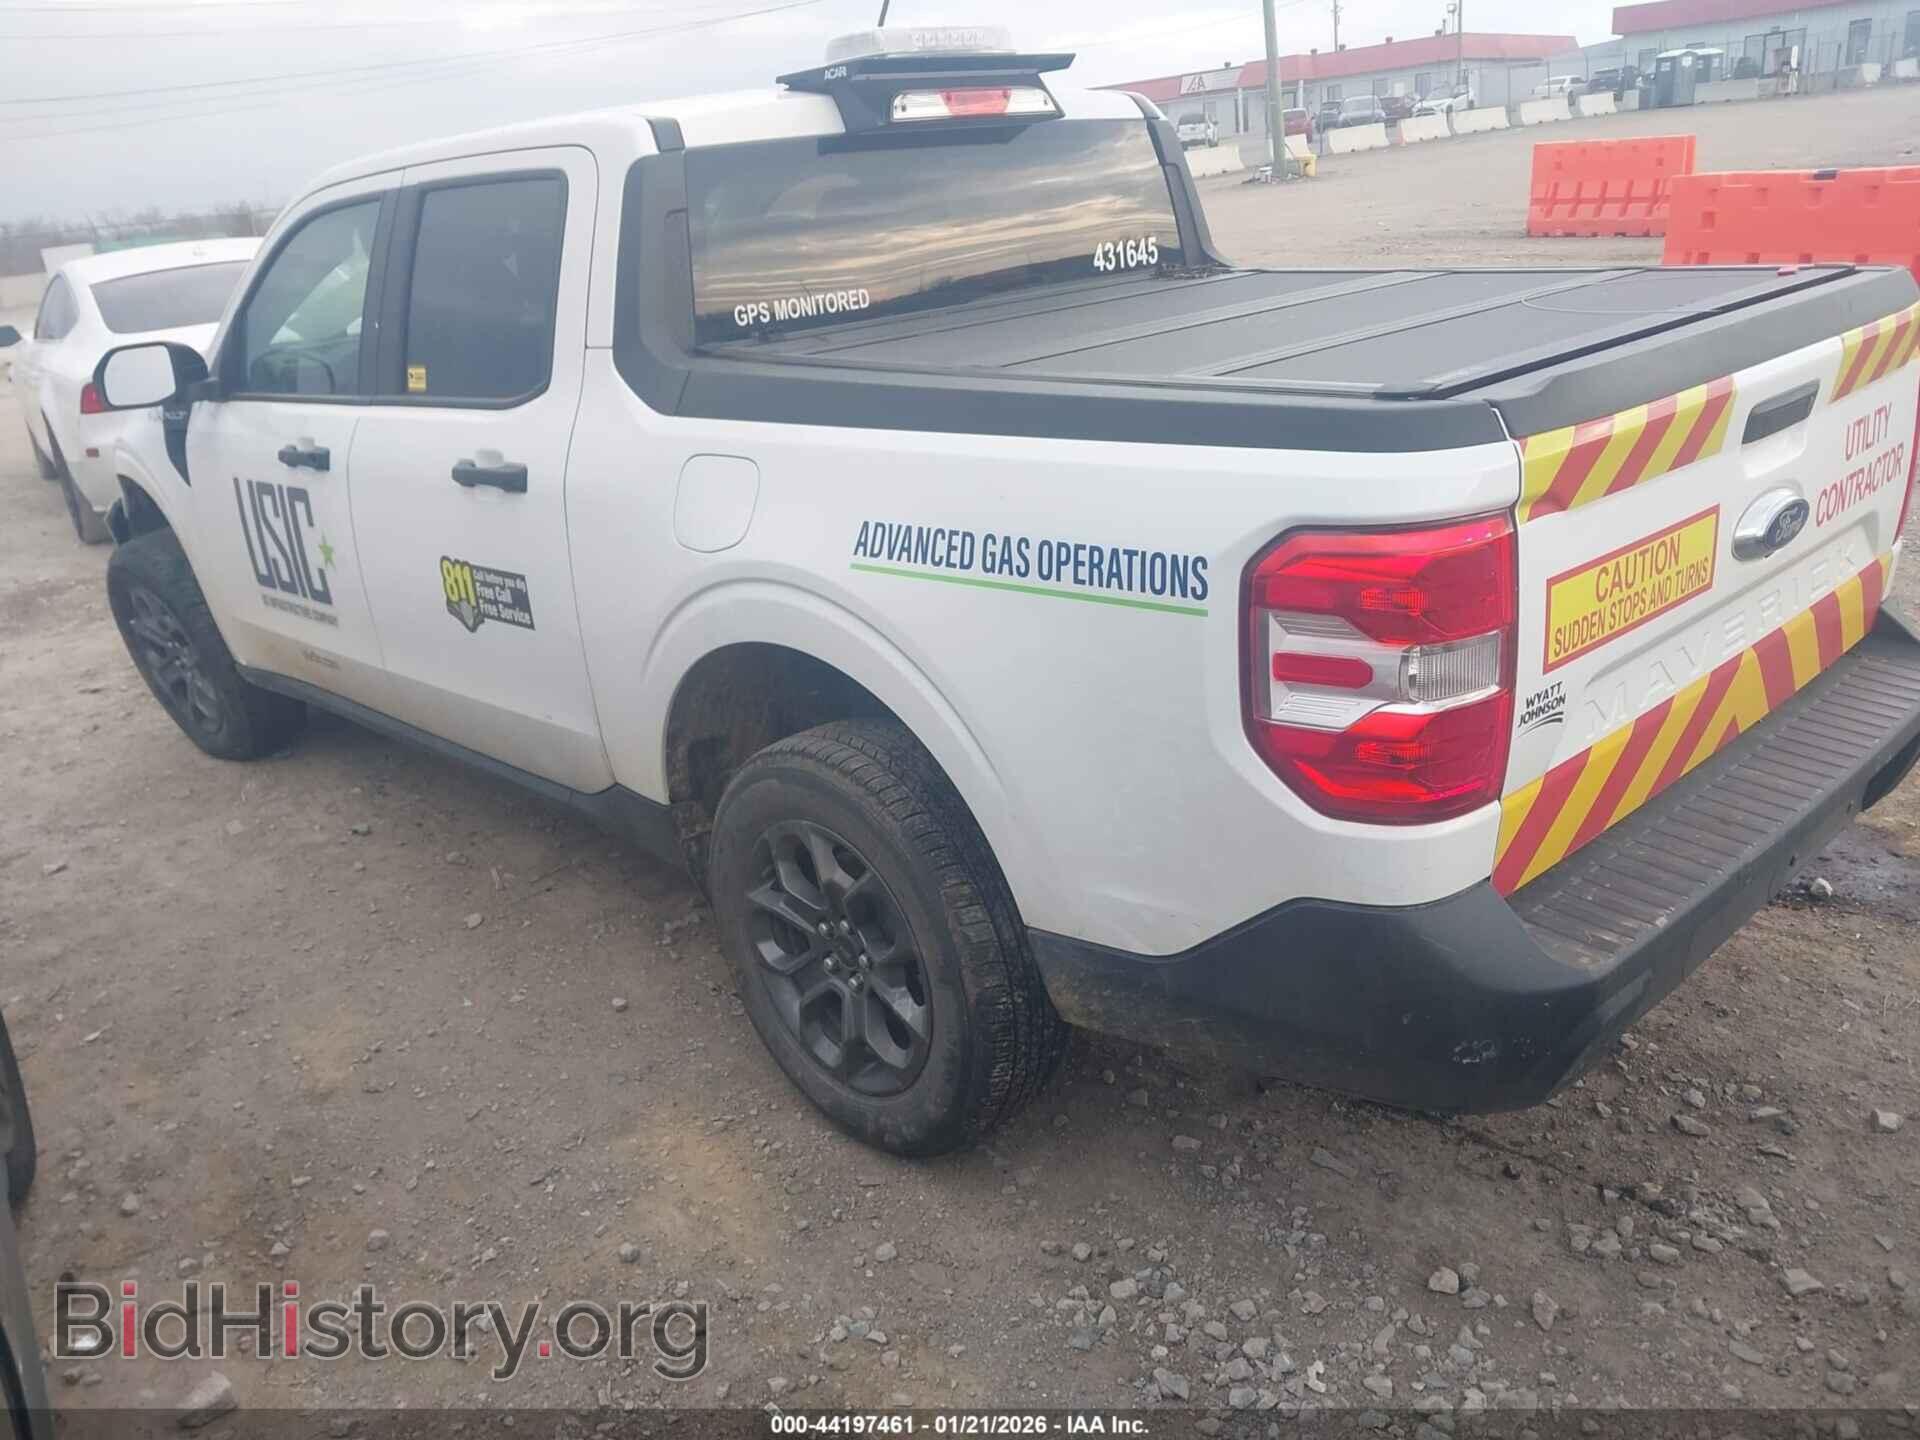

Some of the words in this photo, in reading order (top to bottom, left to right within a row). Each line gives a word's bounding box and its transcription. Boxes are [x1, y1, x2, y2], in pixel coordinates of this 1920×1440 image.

[1093, 236, 1158, 272] 431645
[734, 297, 770, 327] GPS
[774, 289, 870, 321] MONITORED
[1845, 401, 1892, 462] UTILITY
[1816, 442, 1905, 528] CONTRACTOR
[233, 477, 333, 606] USIC
[853, 520, 976, 571] ADVANCED
[982, 533, 1031, 579] GAS
[1037, 539, 1209, 601] OPERATIONS
[1595, 534, 1681, 604] CAUTION
[441, 559, 478, 609] 811
[1553, 609, 1606, 658] SUDDEN
[1609, 590, 1646, 632] STOPS
[1648, 576, 1672, 609] AND
[1675, 557, 1709, 599] TURNS
[1518, 693, 1566, 728] JOHNSON
[1526, 681, 1563, 709] WYATT
